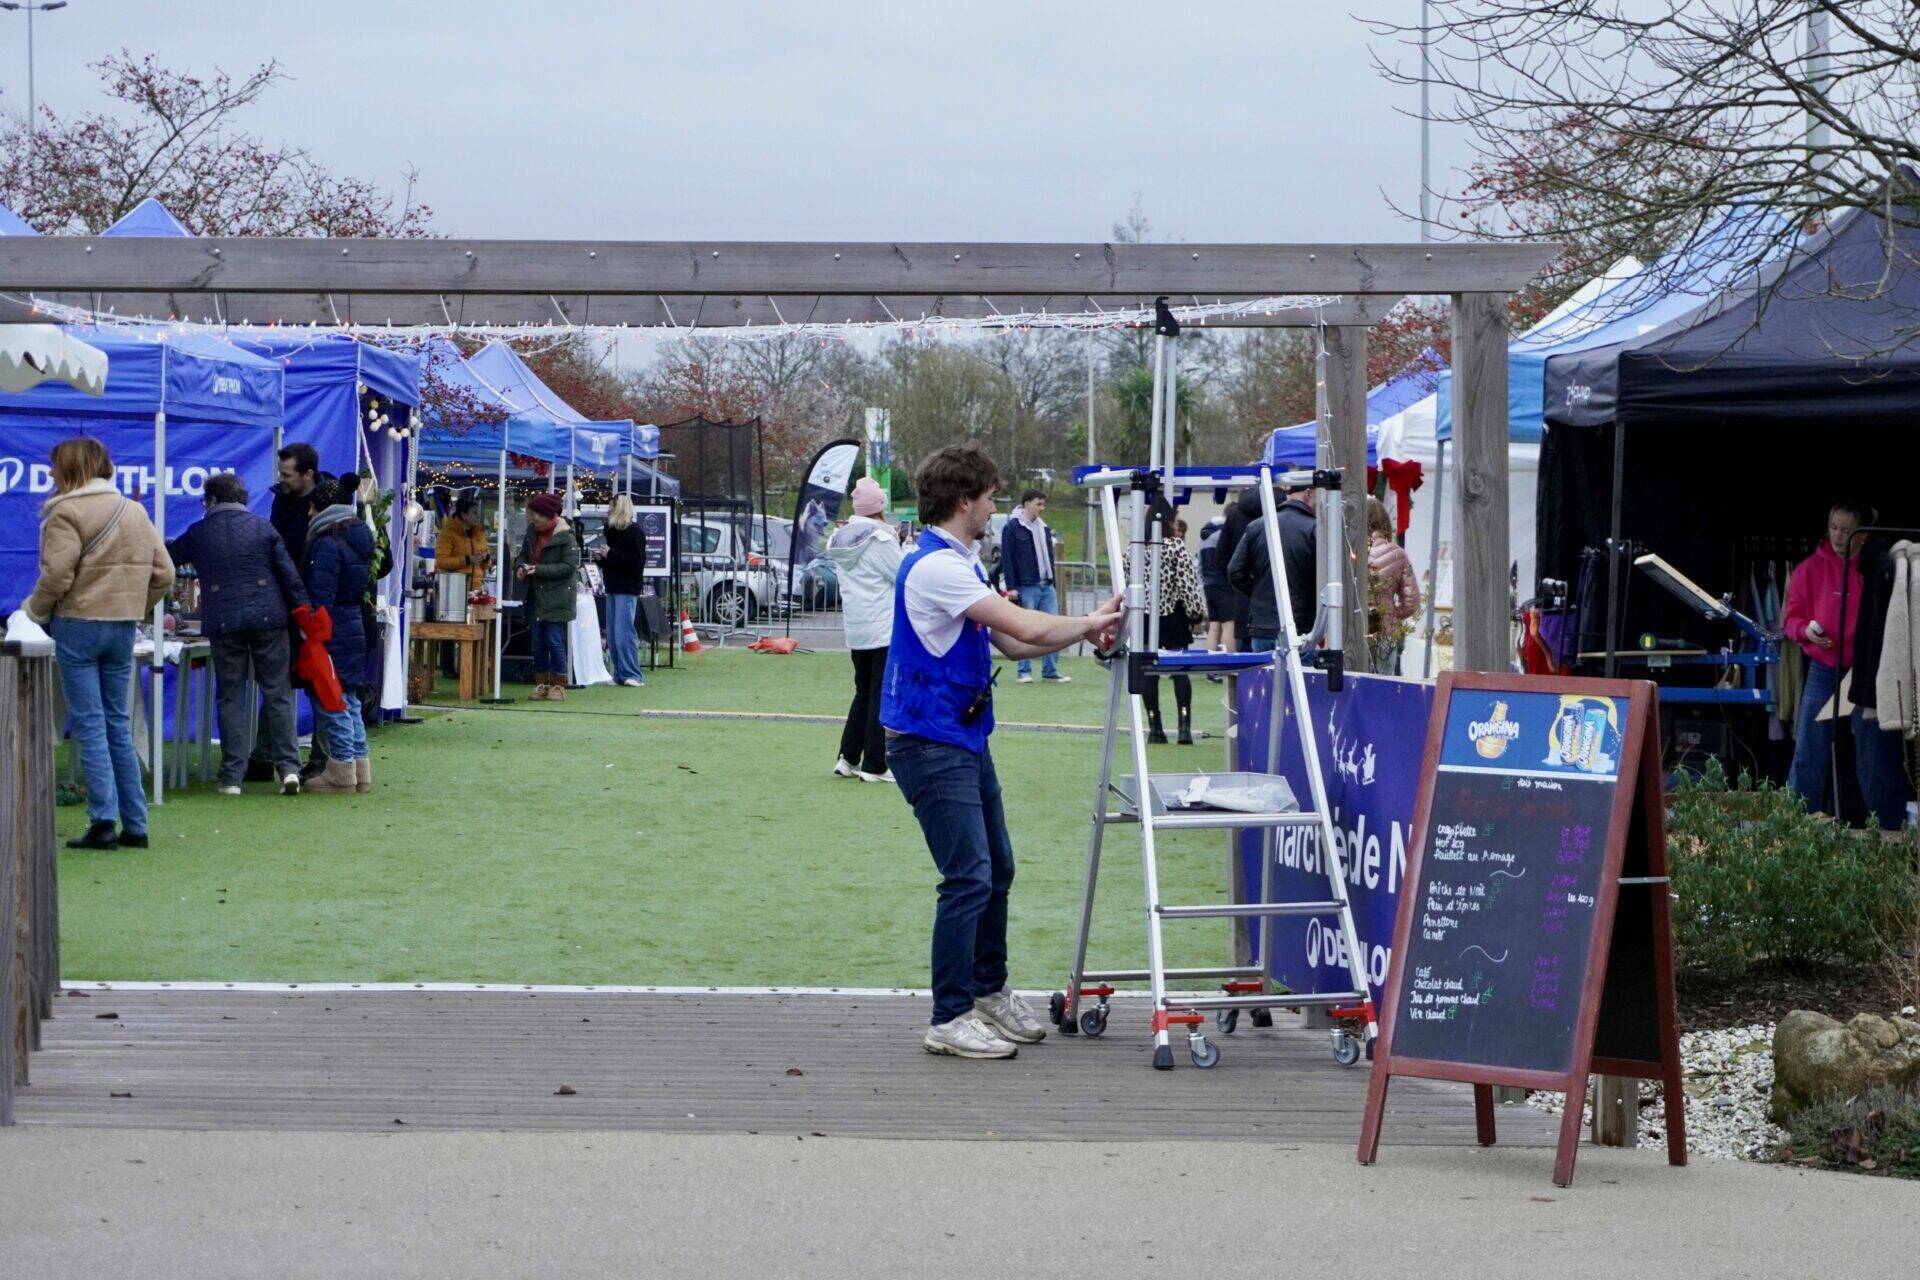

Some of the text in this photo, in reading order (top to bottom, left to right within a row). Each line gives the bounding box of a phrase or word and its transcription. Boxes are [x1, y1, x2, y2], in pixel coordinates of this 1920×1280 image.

[1468, 720, 1520, 741] ORANGINA
[1348, 814, 1380, 890] de
[1467, 852, 1479, 862] au
[1455, 885, 1466, 896] de
[1415, 965, 1432, 979] Café
[1424, 992, 1434, 1004] de
